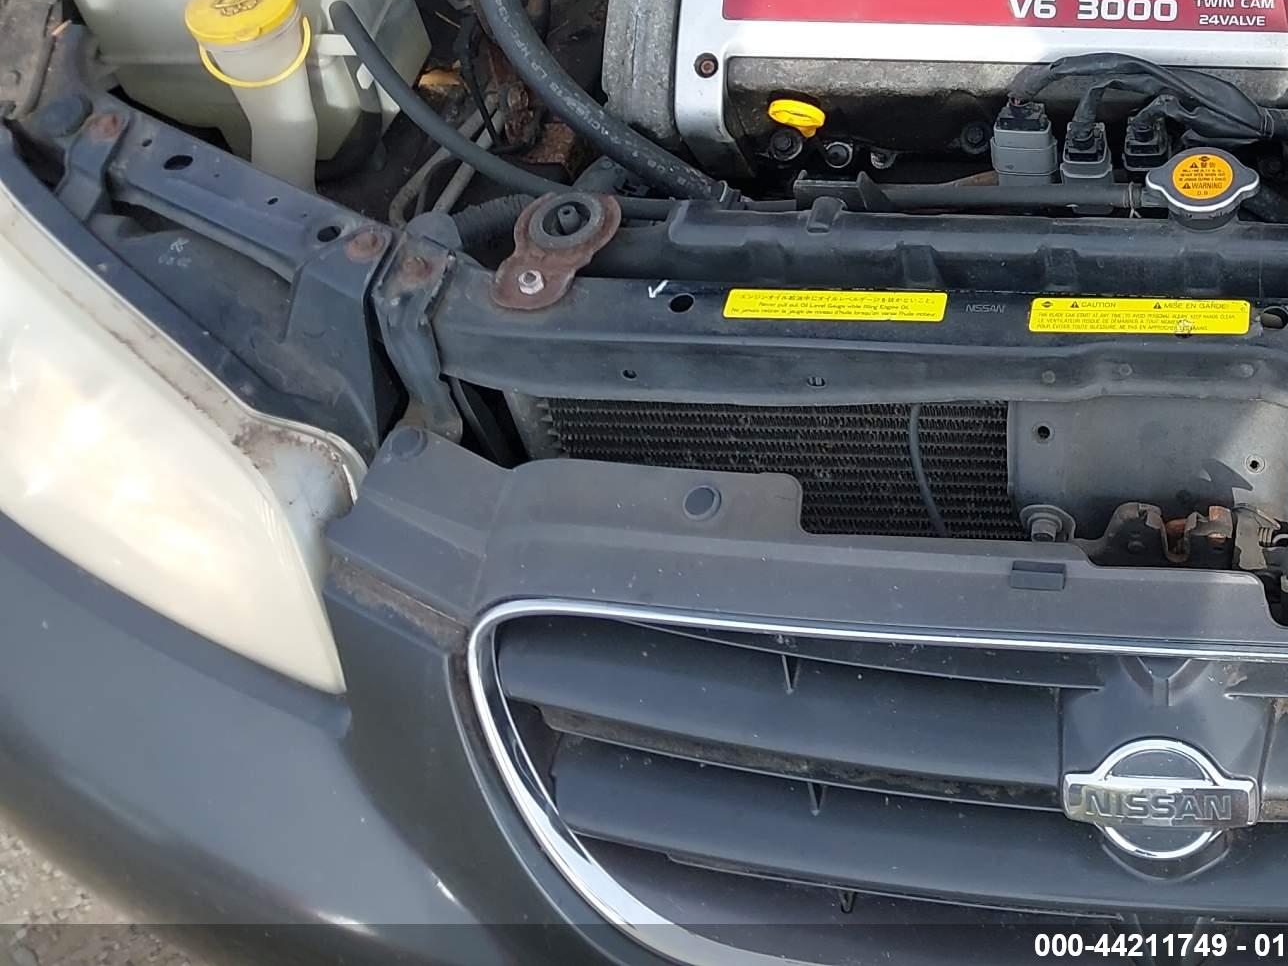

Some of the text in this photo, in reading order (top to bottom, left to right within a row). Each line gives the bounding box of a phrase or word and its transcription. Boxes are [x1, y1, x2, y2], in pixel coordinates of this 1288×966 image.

[1199, 14, 1266, 27] 24VALVE
[1191, 182, 1223, 190] WARNING
[965, 303, 1006, 314] NISSAN
[1081, 301, 1116, 309] CAUTION
[1163, 301, 1183, 309] MISE
[1085, 791, 1231, 821] NISSAN
